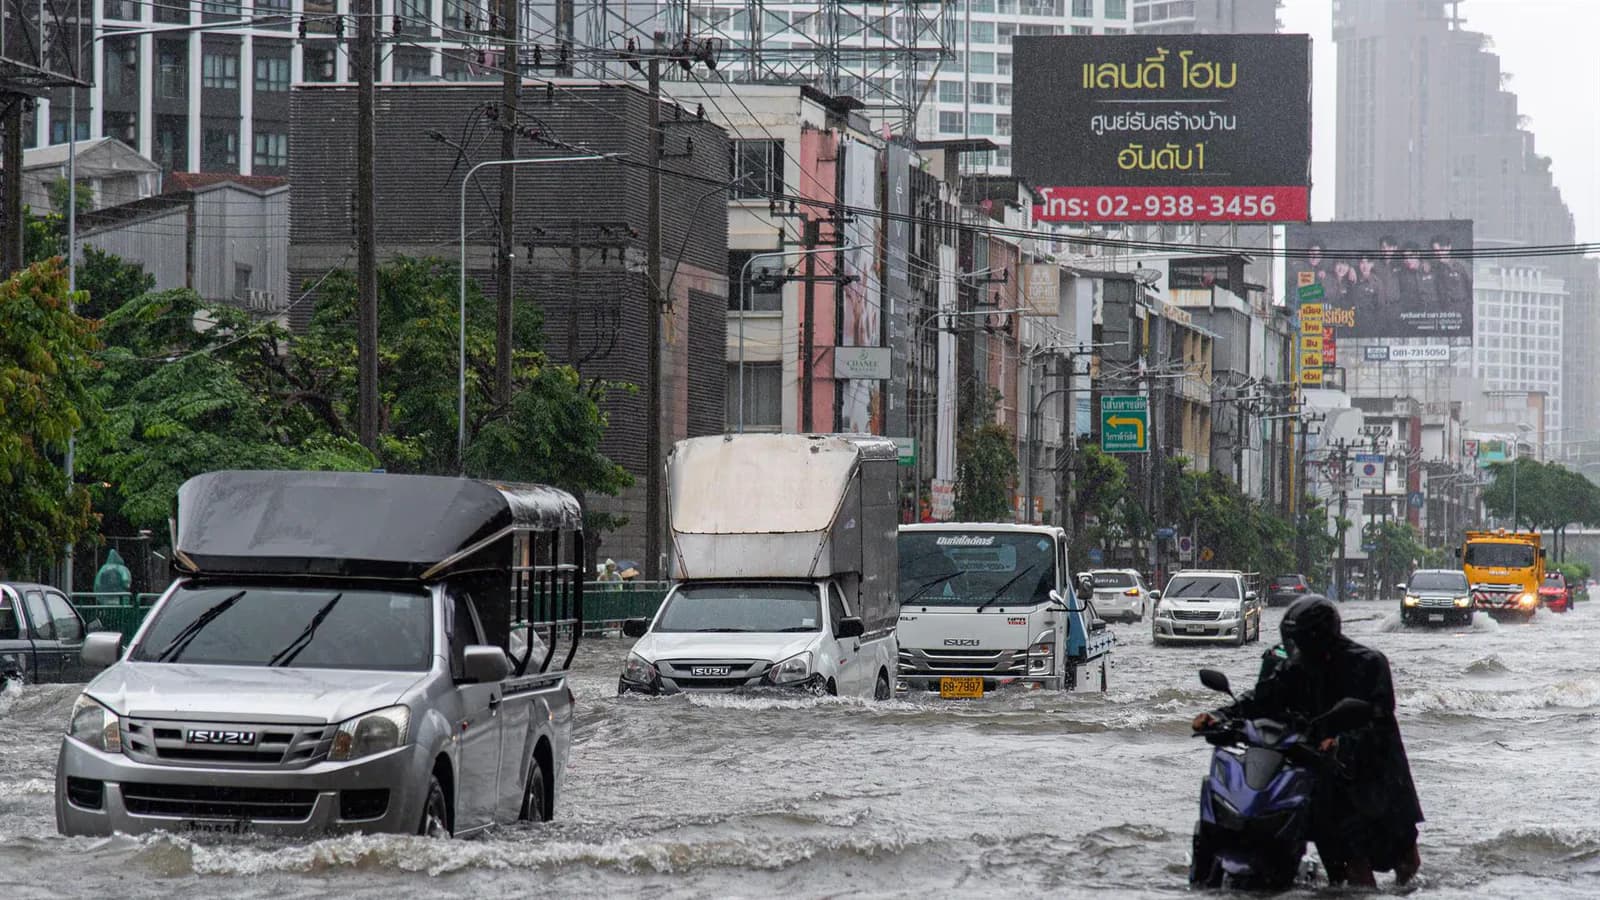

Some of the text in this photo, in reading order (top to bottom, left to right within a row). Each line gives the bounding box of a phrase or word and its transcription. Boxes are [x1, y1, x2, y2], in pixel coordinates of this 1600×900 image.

[1083, 48, 1237, 89] แลนดี้ โฮม
[1091, 111, 1236, 136] ศูนย์รับสร้างบ้าน
[1096, 195, 1276, 217] 02-938-3456
[692, 668, 729, 676] ISUZU
[188, 730, 254, 744] ISUZU
